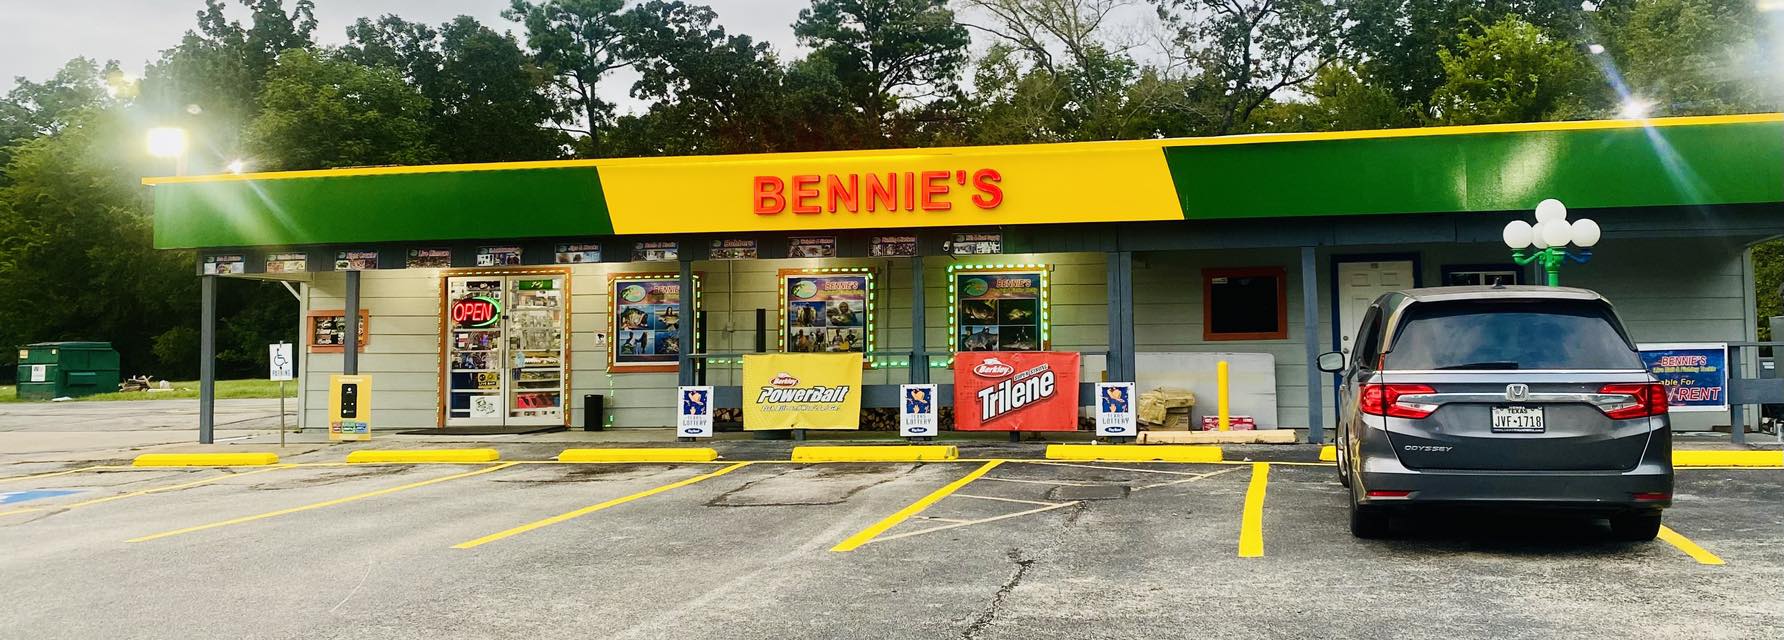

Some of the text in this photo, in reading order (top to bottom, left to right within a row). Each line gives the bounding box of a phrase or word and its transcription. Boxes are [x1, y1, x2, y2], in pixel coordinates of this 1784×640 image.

[753, 168, 1004, 215] BENNIE'S
[453, 303, 493, 322] OPEN
[1660, 355, 1707, 367] BENNIE'S
[979, 365, 1010, 376] Berkley
[757, 386, 849, 404] PowerBait
[978, 371, 1055, 420] Trilene
[1679, 387, 1721, 402] RENT
